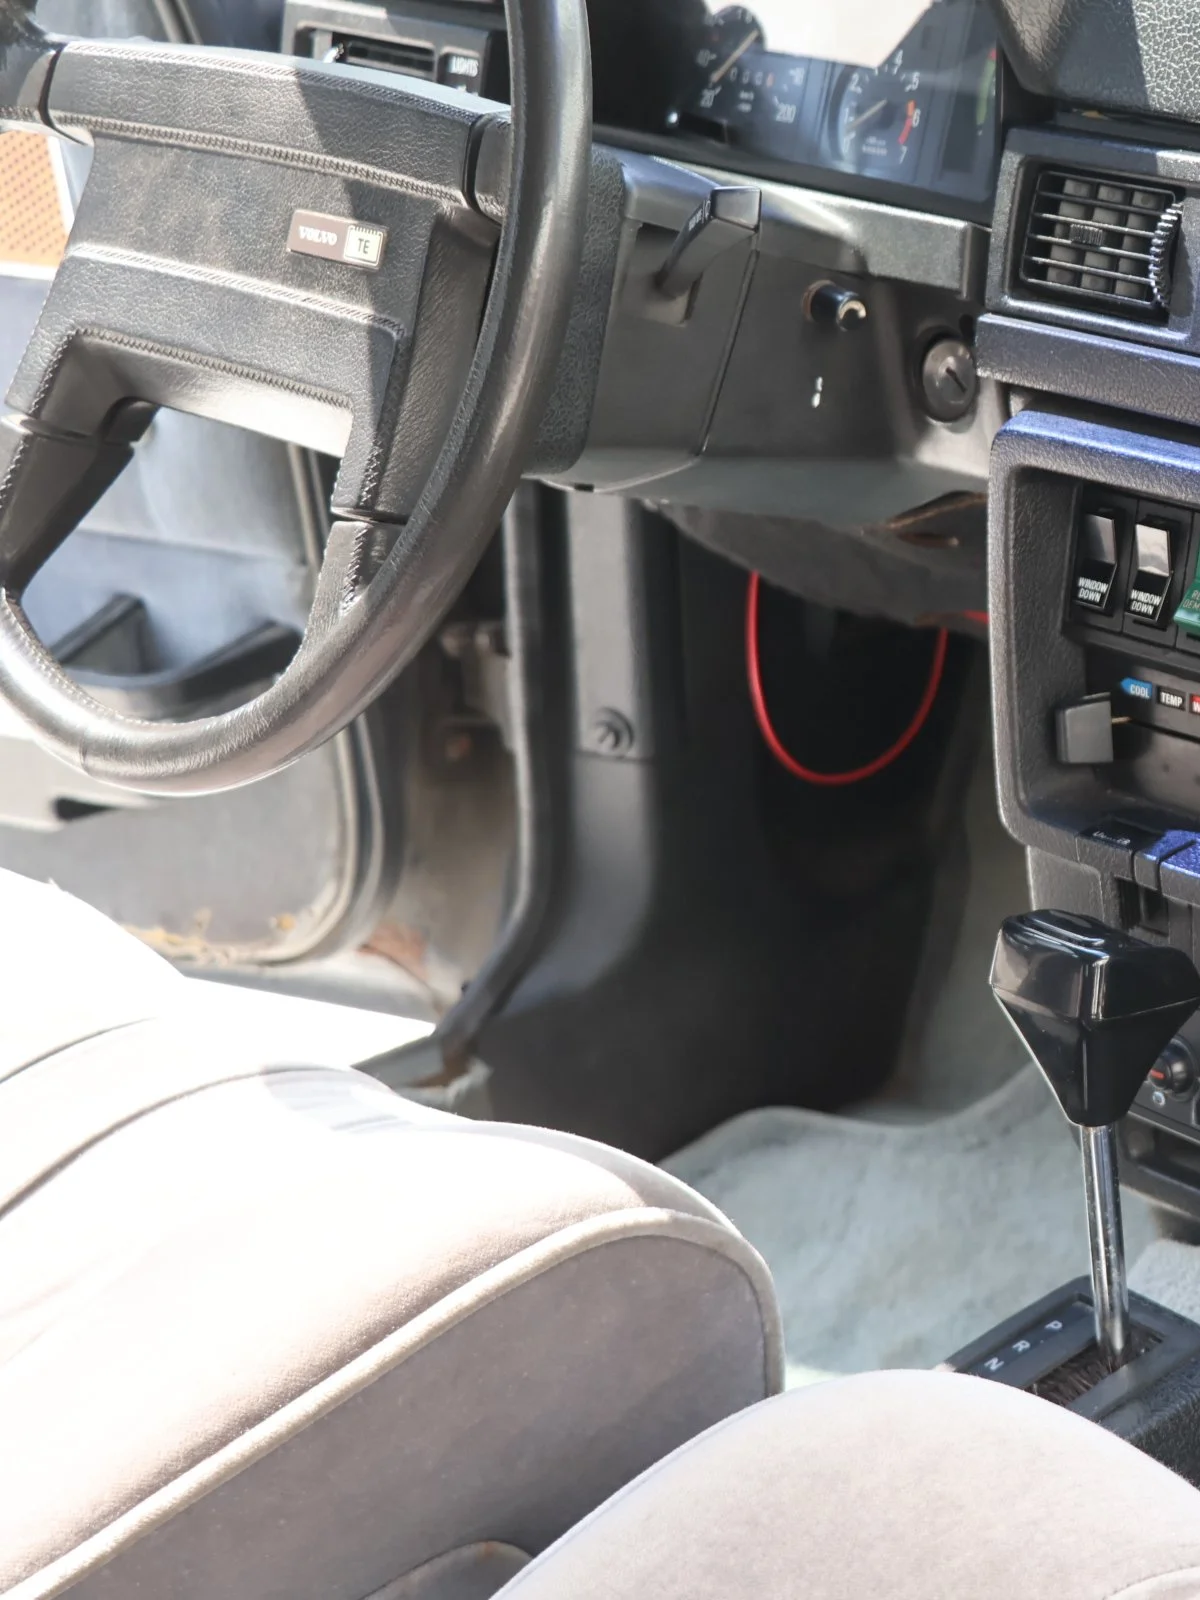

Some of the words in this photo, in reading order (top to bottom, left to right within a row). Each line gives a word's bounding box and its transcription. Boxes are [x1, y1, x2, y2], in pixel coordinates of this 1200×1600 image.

[450, 55, 478, 77] LIGHTS
[850, 72, 859, 90] 2
[911, 72, 920, 90] 5
[776, 103, 797, 123] 200
[912, 108, 921, 127] 6
[899, 146, 907, 164] 7
[299, 225, 338, 246] VOLVO
[358, 238, 370, 255] TE
[1078, 577, 1109, 593] WINDOW
[1078, 587, 1101, 603] DOWN
[1130, 589, 1162, 606] WINDOW
[1130, 600, 1154, 615] DOWN
[1129, 684, 1150, 699] COOL
[1161, 692, 1183, 707] TEMP
[1045, 1320, 1063, 1330] P
[1011, 1340, 1031, 1353] R
[983, 1357, 1005, 1373] N
